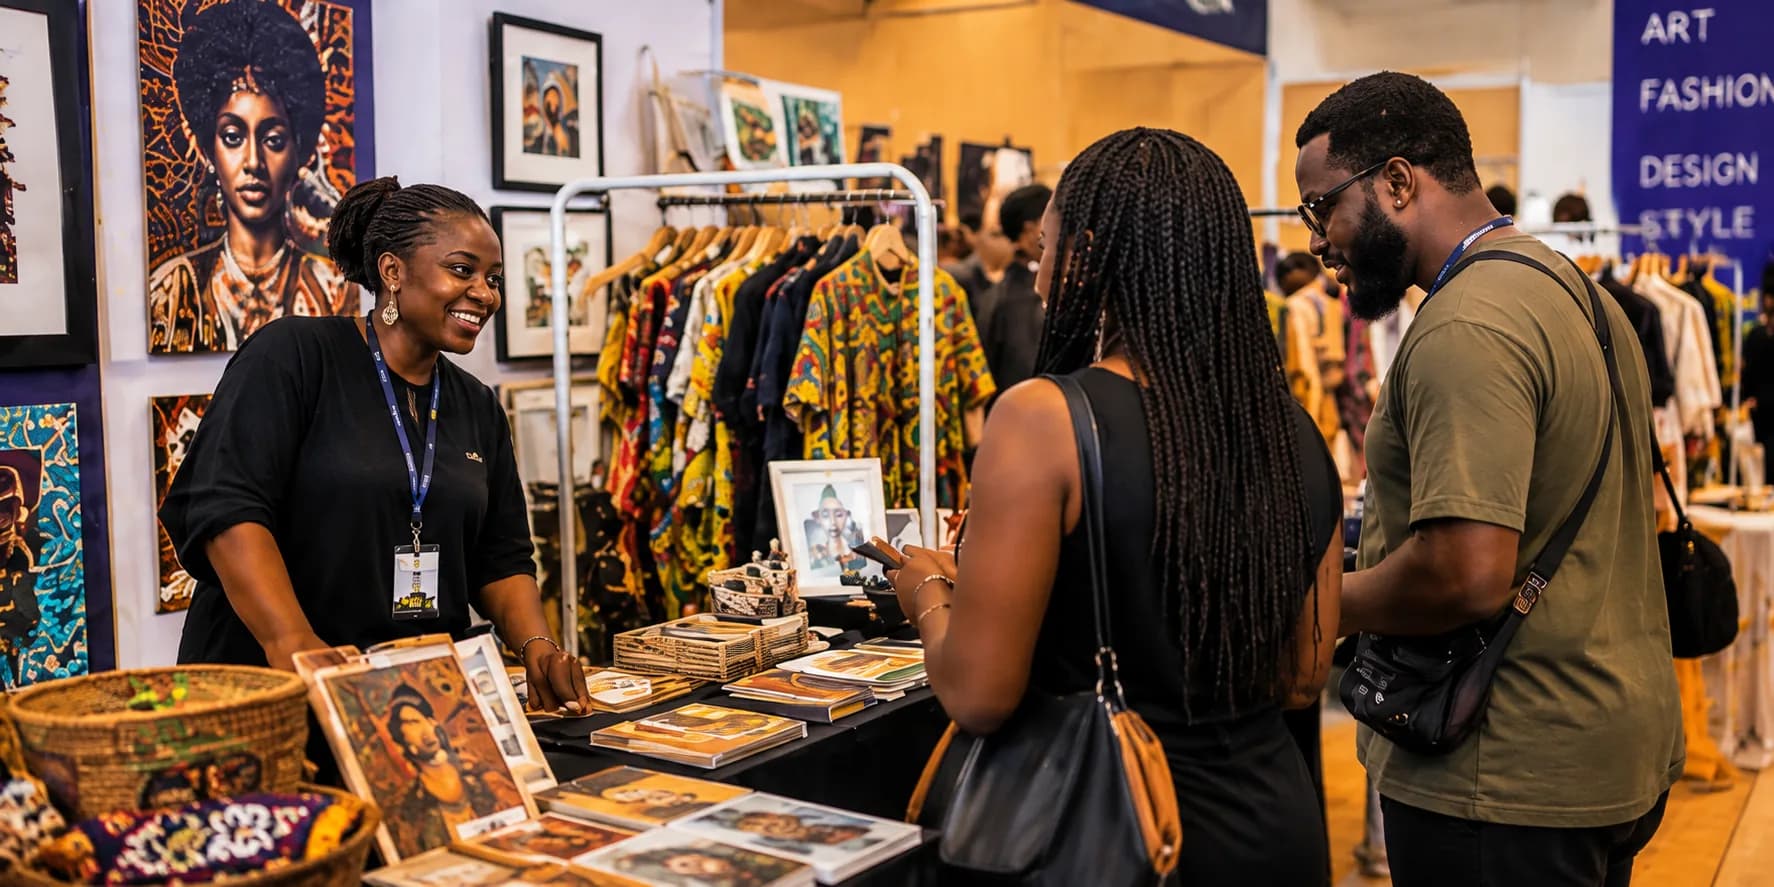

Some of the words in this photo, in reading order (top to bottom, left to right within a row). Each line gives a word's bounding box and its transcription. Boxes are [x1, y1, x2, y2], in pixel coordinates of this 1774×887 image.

[1641, 8, 1715, 45] ART
[1640, 73, 1774, 113] FASHION
[1640, 152, 1758, 188] DESIGN
[1639, 206, 1755, 241] STYLE
